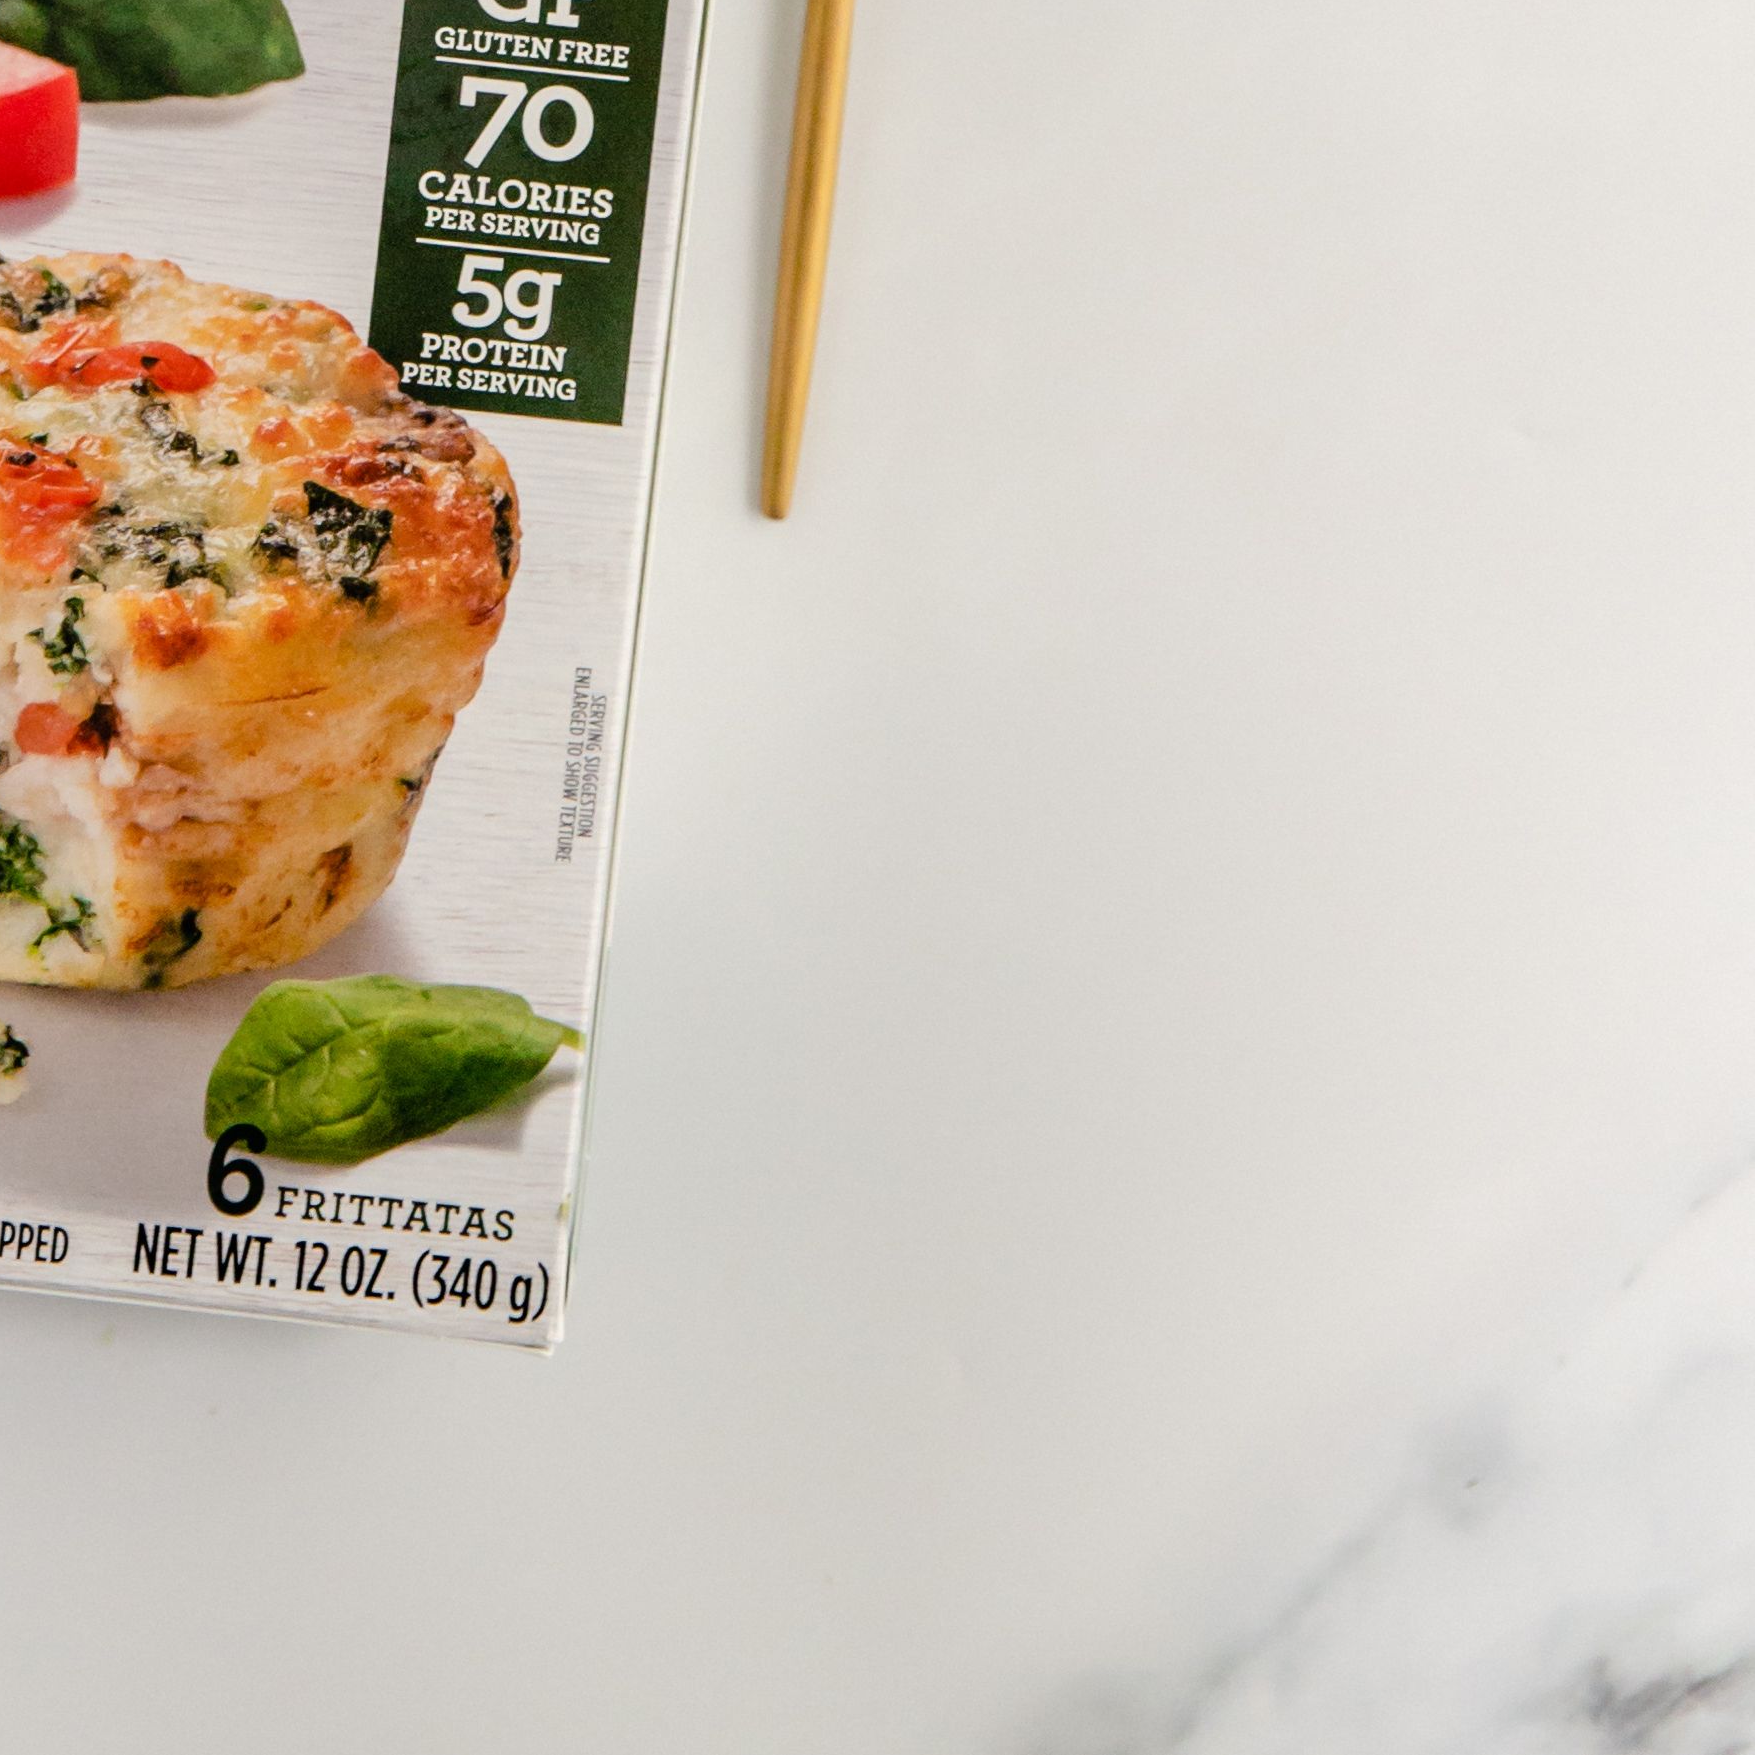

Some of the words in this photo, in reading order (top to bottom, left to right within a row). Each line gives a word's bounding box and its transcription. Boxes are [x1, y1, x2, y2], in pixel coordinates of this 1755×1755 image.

[435, 27, 551, 61] GLUTEN
[558, 42, 630, 69] FREE
[459, 76, 594, 168] 70
[418, 171, 613, 219] CALORIES
[425, 208, 475, 232] PER
[480, 213, 600, 245] SERVING
[452, 254, 562, 341] 5g
[420, 333, 567, 372] PROTEIN
[401, 362, 452, 386] PER
[456, 368, 576, 401] SERVING
[569, 667, 592, 736] ENLARGED
[585, 695, 606, 751] SERVING
[567, 741, 583, 757] TO
[562, 761, 580, 801] SHOW
[577, 756, 600, 838] SUGGESTION
[555, 806, 577, 863] TEXTURE
[207, 1123, 267, 1216] 6
[274, 1186, 514, 1241] FRITTATAS
[133, 1222, 203, 1278] NET
[215, 1231, 277, 1288] WT.
[294, 1240, 329, 1292] 12
[341, 1246, 395, 1300] OZ.
[412, 1249, 497, 1309] (340
[509, 1261, 549, 1323] g)
